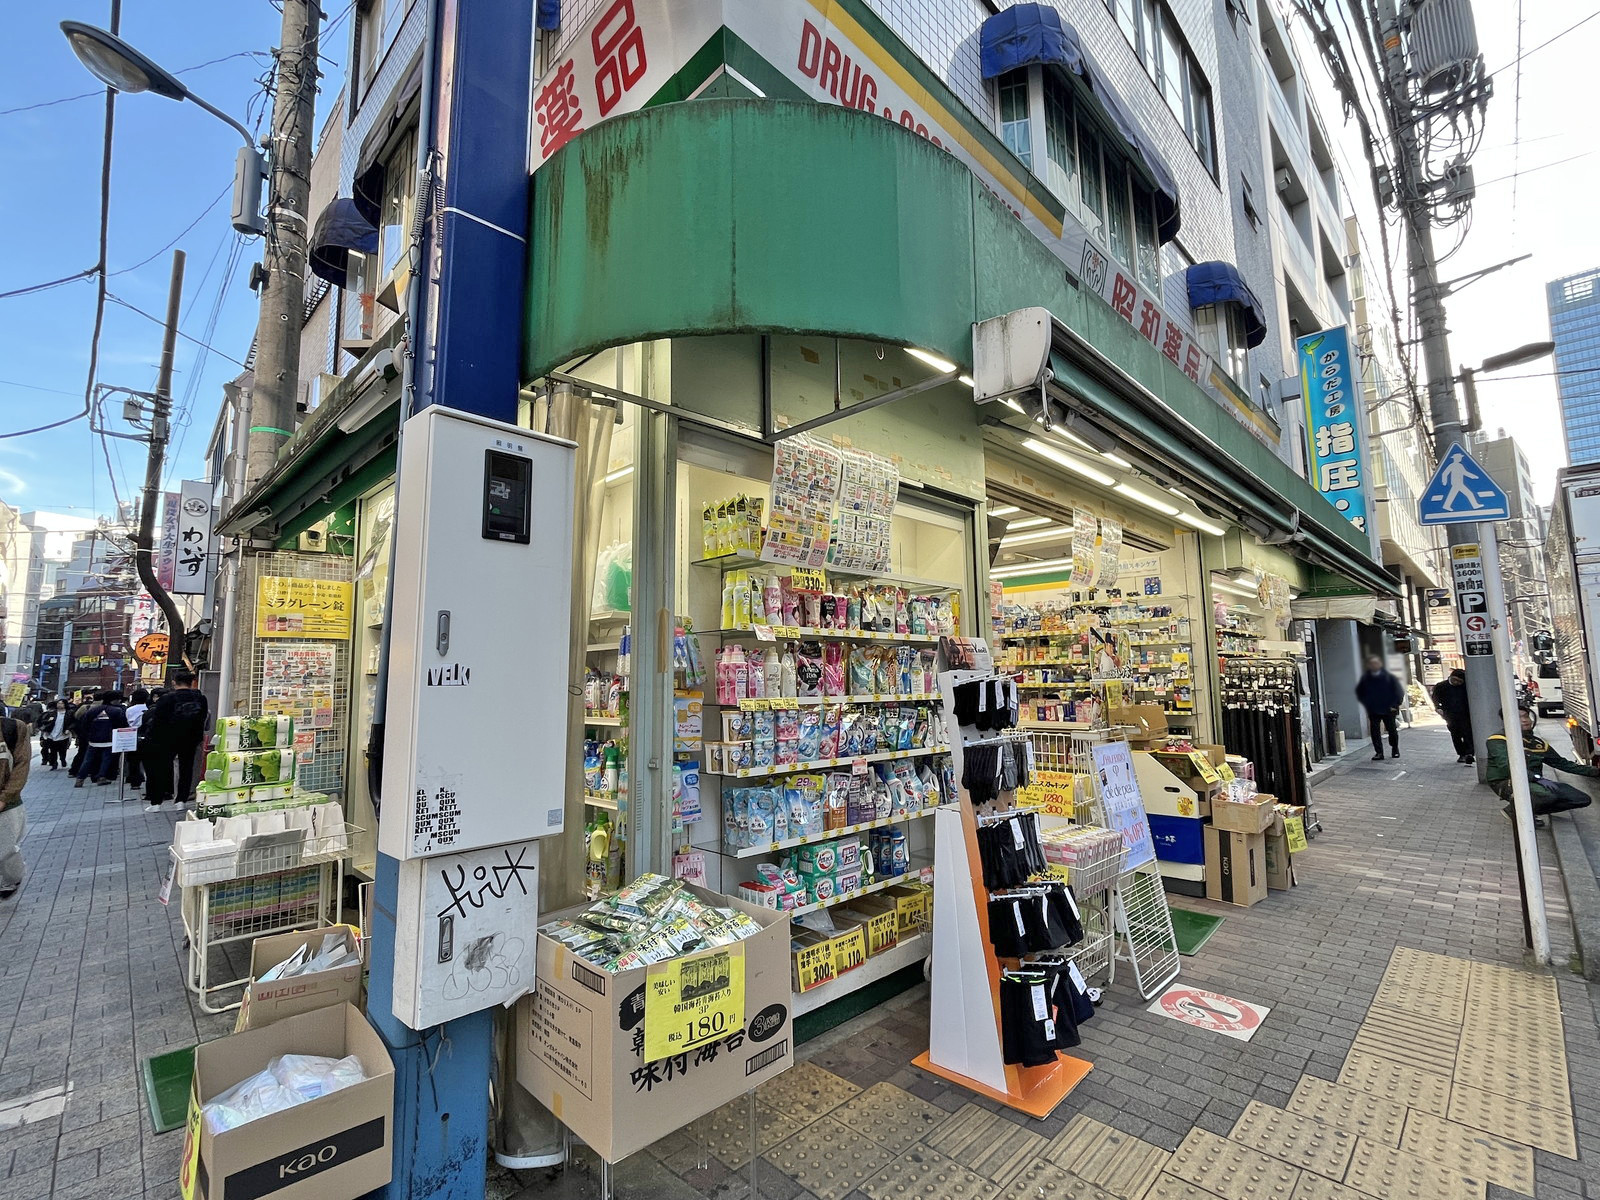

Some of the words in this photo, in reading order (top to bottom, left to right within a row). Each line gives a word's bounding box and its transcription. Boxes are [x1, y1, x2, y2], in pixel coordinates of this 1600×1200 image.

[798, 18, 878, 114] DRUG
[1321, 350, 1344, 418] からだ工房
[178, 526, 206, 577] わいず
[805, 576, 821, 591] 330
[266, 597, 345, 611] ミラグレーン錠
[1462, 593, 1484, 613] P
[415, 812, 438, 821] SCUM
[438, 809, 462, 819] SCUM
[881, 928, 894, 946] 110
[848, 948, 861, 968] 110
[813, 961, 830, 983] 300
[673, 988, 732, 1015] 韓国海苔青海苔入り
[698, 1005, 710, 1015] 3P
[668, 1031, 683, 1043] 税込
[686, 1011, 725, 1043] 180
[729, 1013, 736, 1024] 円
[279, 1144, 338, 1179] Kao
